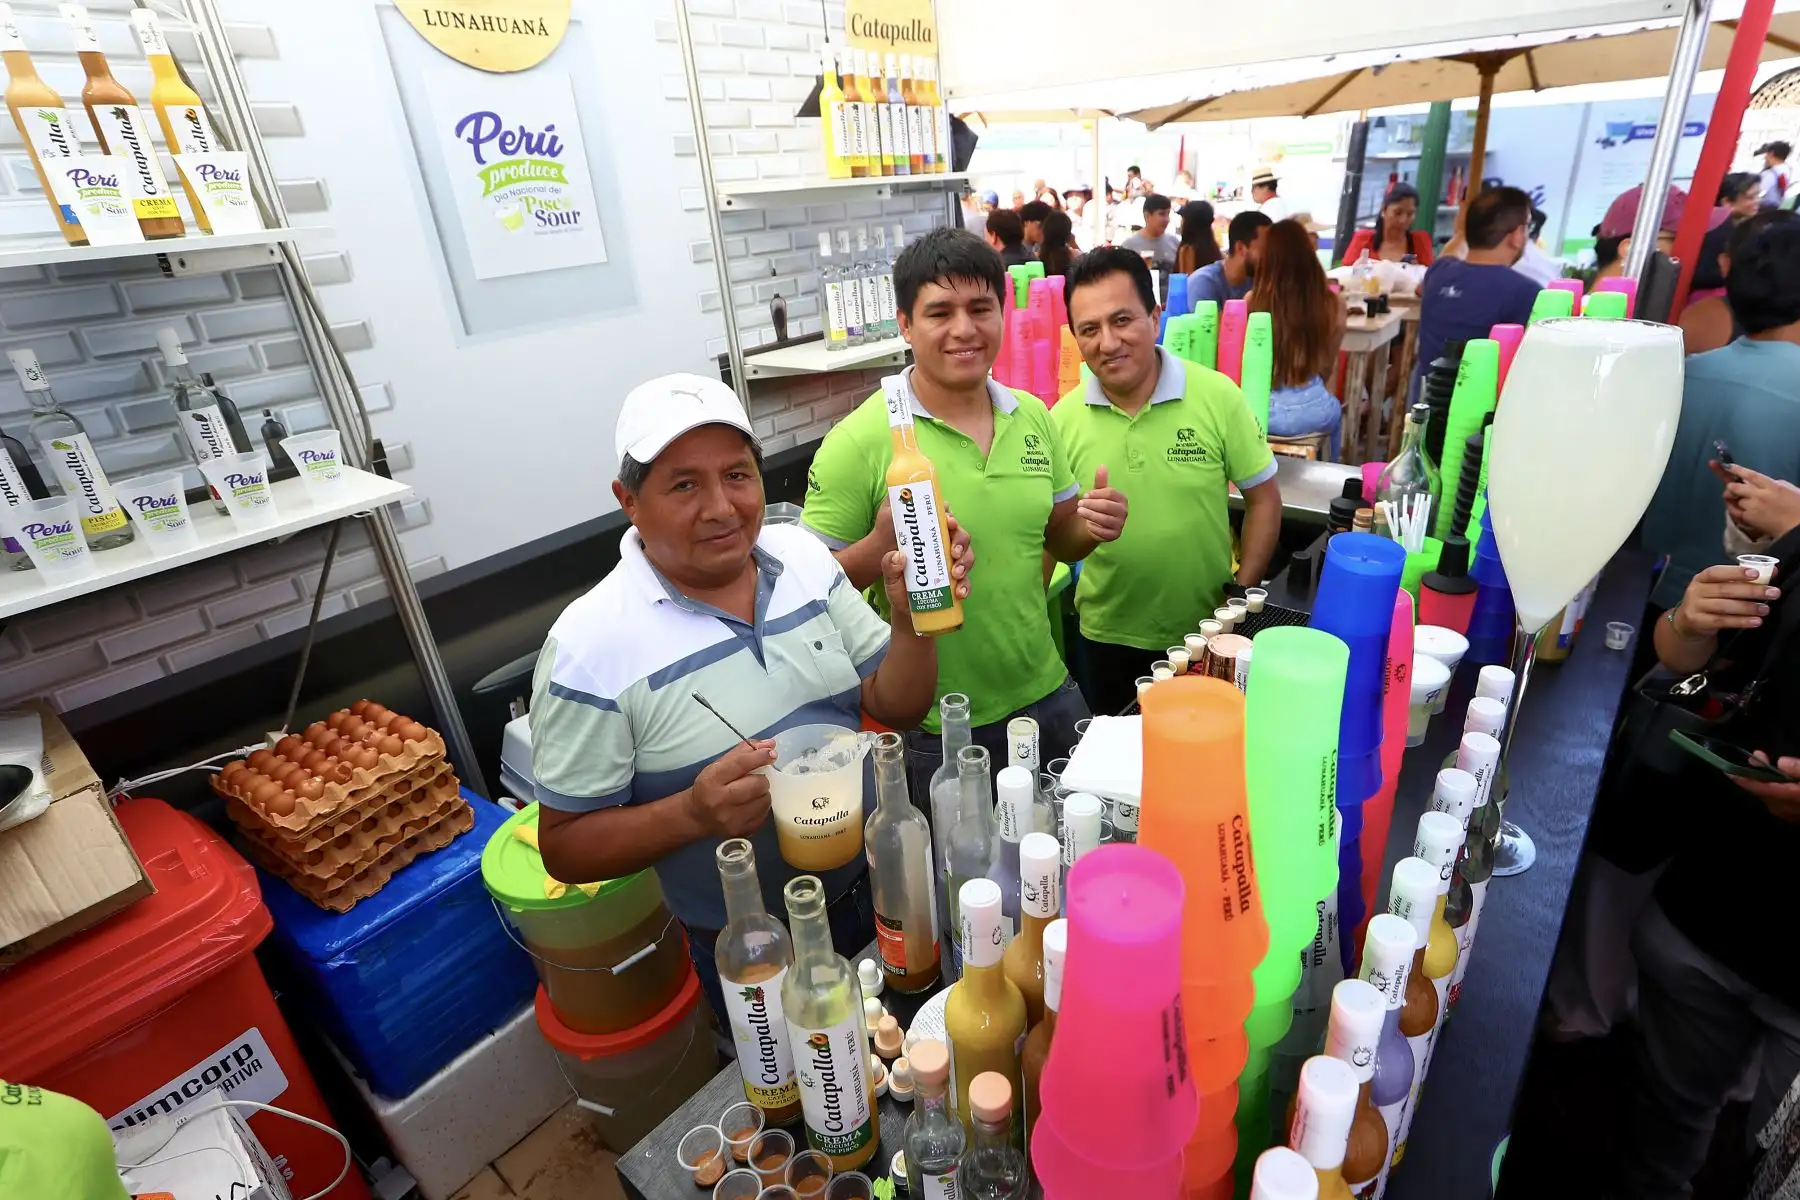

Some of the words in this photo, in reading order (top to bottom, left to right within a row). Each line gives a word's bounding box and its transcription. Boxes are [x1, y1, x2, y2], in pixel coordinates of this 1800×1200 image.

[423, 9, 550, 36] LUNAHUANÁ
[851, 12, 932, 46] Catapalla
[455, 110, 563, 165] Perú
[120, 119, 157, 195] Catapalla
[67, 168, 120, 188] Perú
[196, 164, 241, 181] Perú
[489, 160, 560, 191] produce
[509, 185, 547, 197] Nacional
[140, 199, 172, 207] CREMA
[535, 208, 581, 228] Sour
[298, 449, 337, 463] Perú
[1167, 447, 1206, 457] Catapalla
[66, 451, 104, 514] Catapalla
[223, 472, 264, 489] Perú
[132, 494, 178, 511] Perú
[923, 494, 934, 516] PERÚ
[87, 512, 117, 524] PISCO
[22, 520, 74, 540] Perú
[903, 501, 929, 587] Catapalla
[929, 526, 945, 577] LUNAHUANÁ
[911, 589, 944, 601] CREMA
[1328, 748, 1337, 840] Catapalla
[793, 810, 849, 826] Catapalla
[1318, 823, 1326, 847] PERÚ
[1232, 814, 1252, 915] Catapalla
[1040, 874, 1050, 913] Catapalla
[747, 999, 780, 1085] Catapalla
[843, 1031, 857, 1056] PERÚ
[753, 1080, 799, 1097] CREMA
[776, 1094, 797, 1104] PISCO
[812, 1048, 843, 1133] Catapalla
[815, 1129, 862, 1144] CREMA
